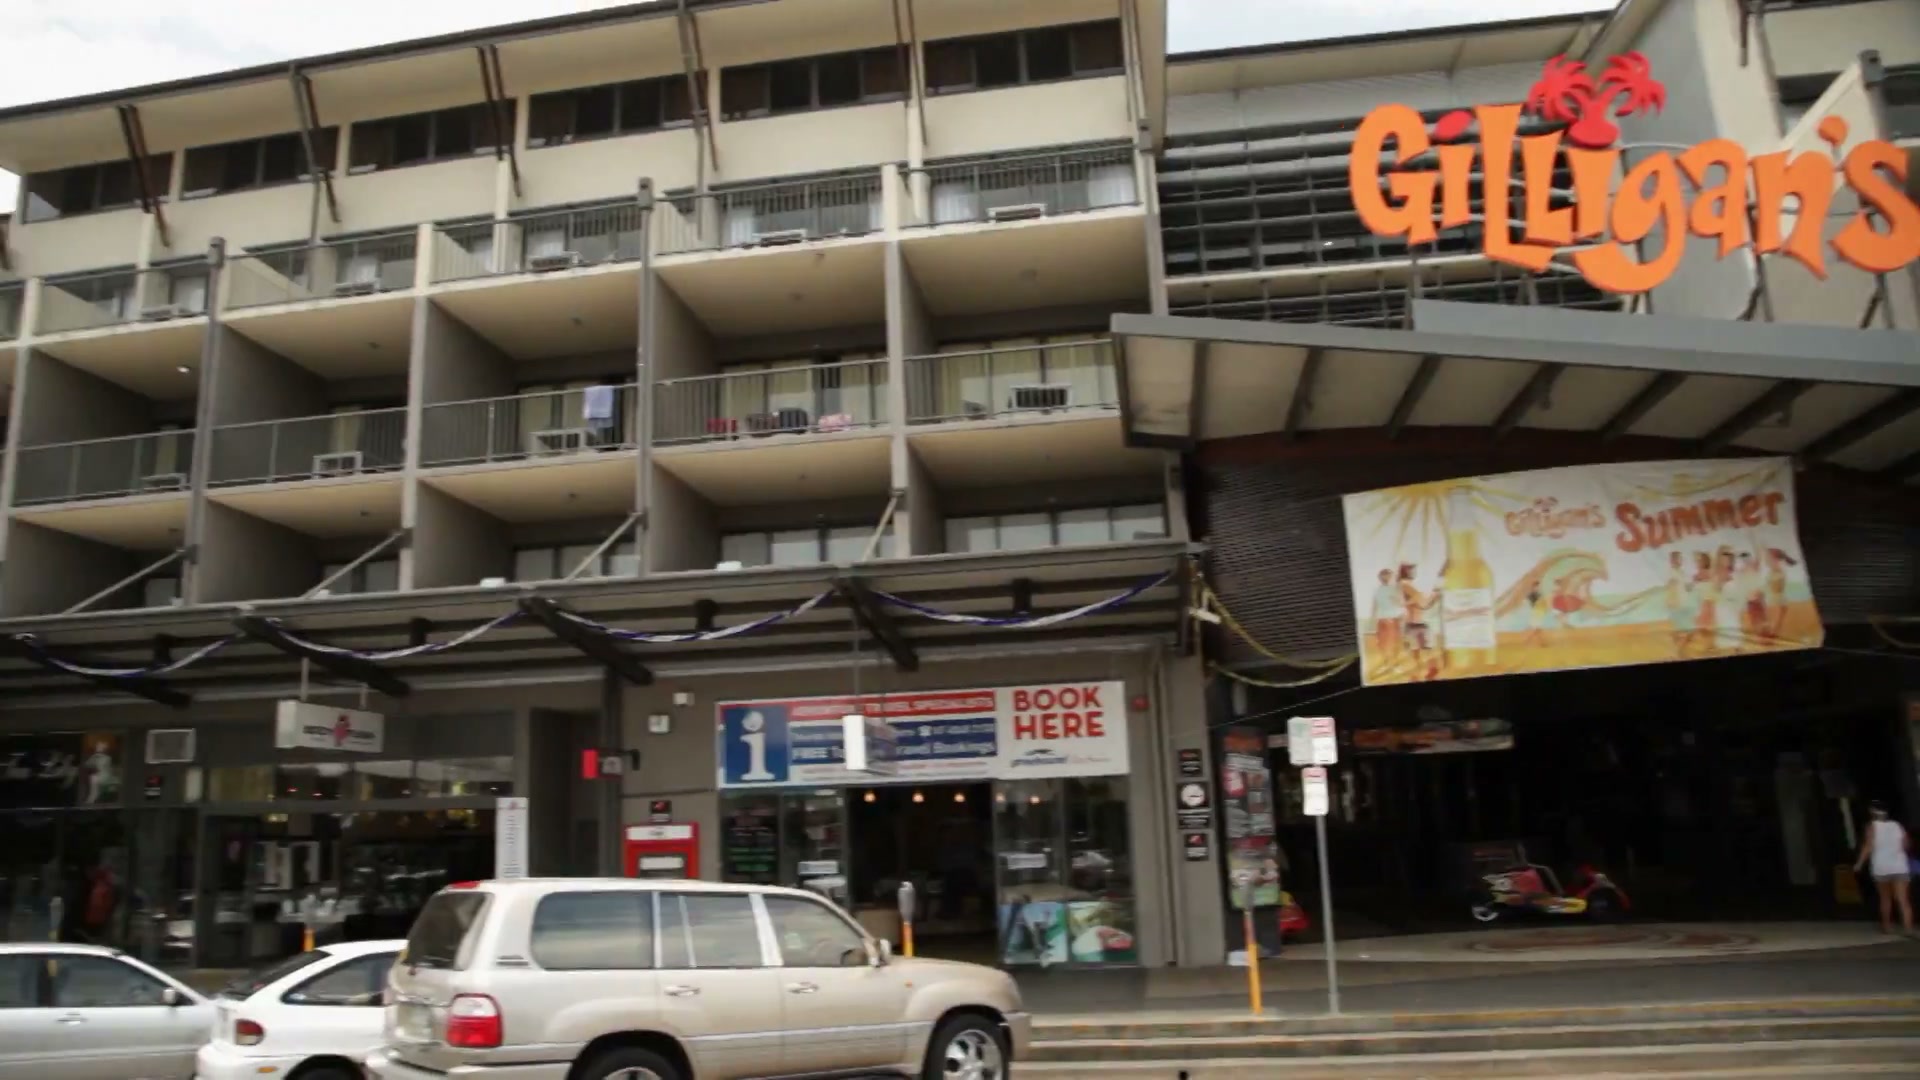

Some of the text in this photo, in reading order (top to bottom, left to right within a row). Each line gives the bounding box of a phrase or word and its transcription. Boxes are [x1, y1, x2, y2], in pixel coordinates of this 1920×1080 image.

[1615, 491, 1785, 552] Summer
[1013, 687, 1102, 712] BOOK
[1013, 711, 1106, 740] HERE
